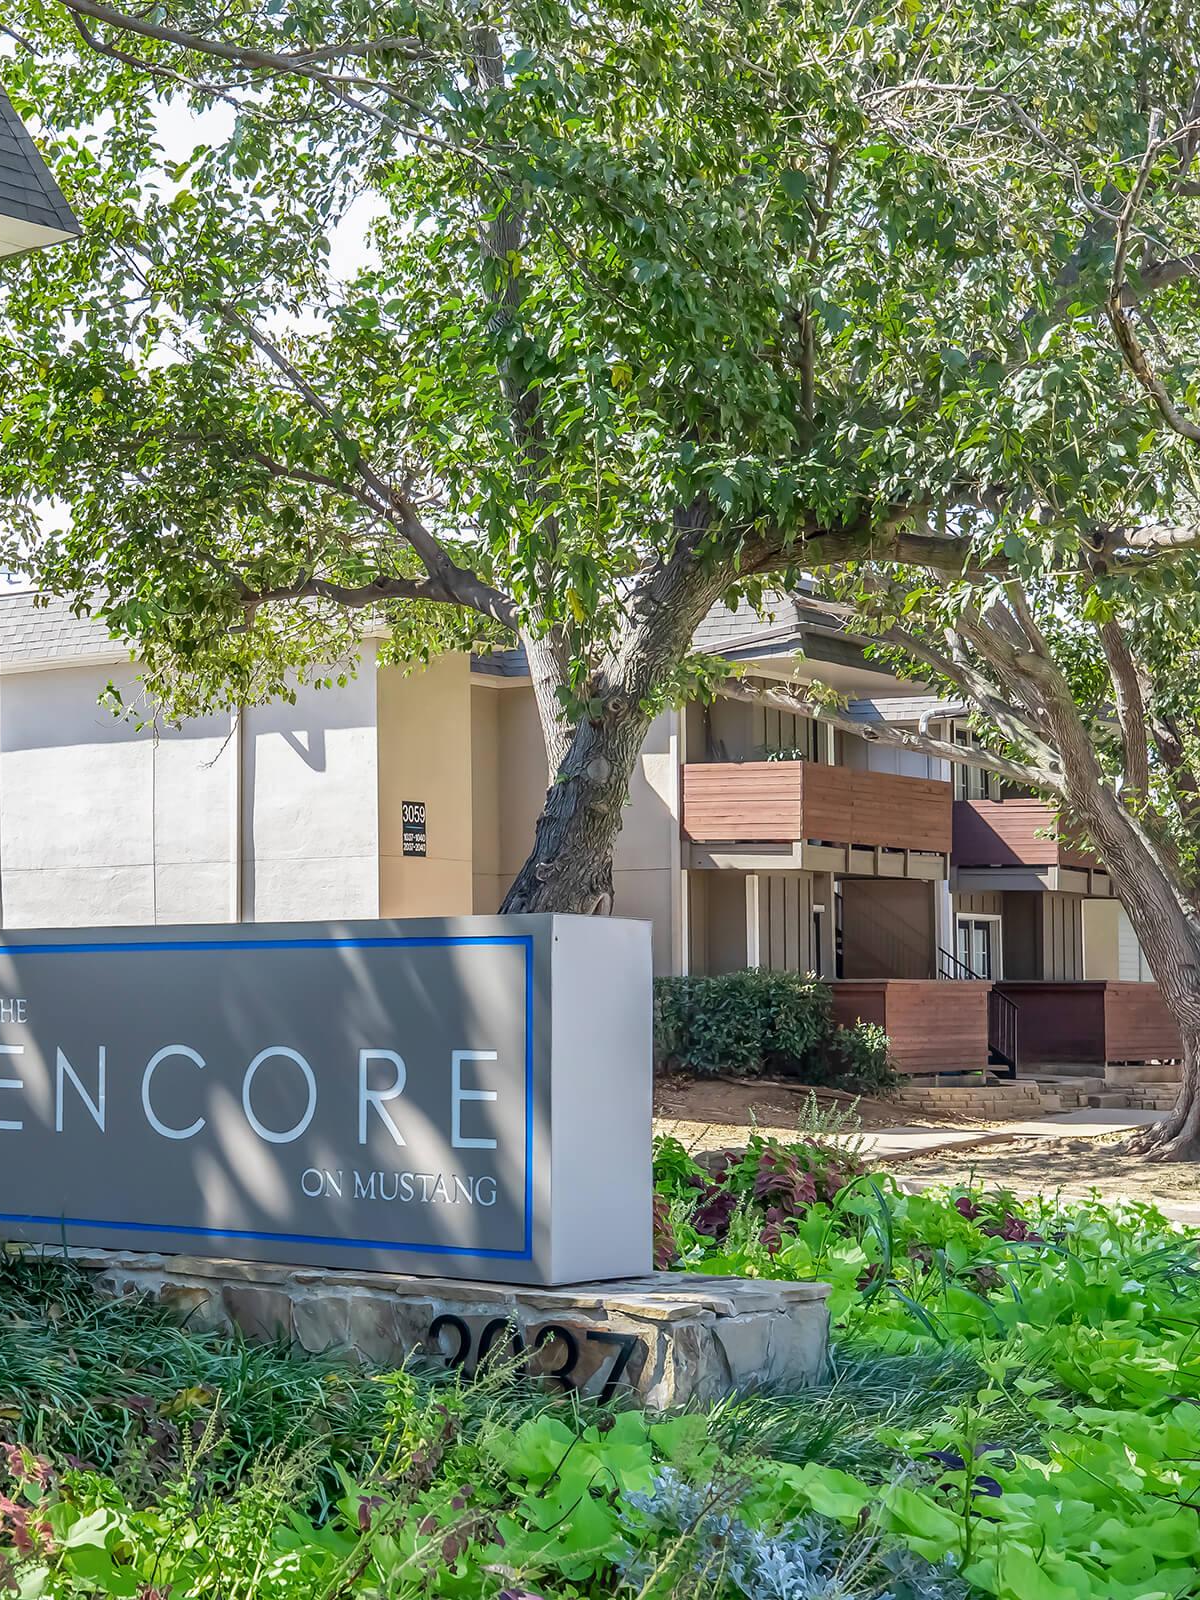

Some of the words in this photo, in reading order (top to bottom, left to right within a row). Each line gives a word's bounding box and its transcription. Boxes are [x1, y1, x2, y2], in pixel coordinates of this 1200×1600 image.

[403, 804, 425, 823] 3059
[301, 1168, 344, 1198] ON
[353, 1170, 498, 1207] MUSTANG
